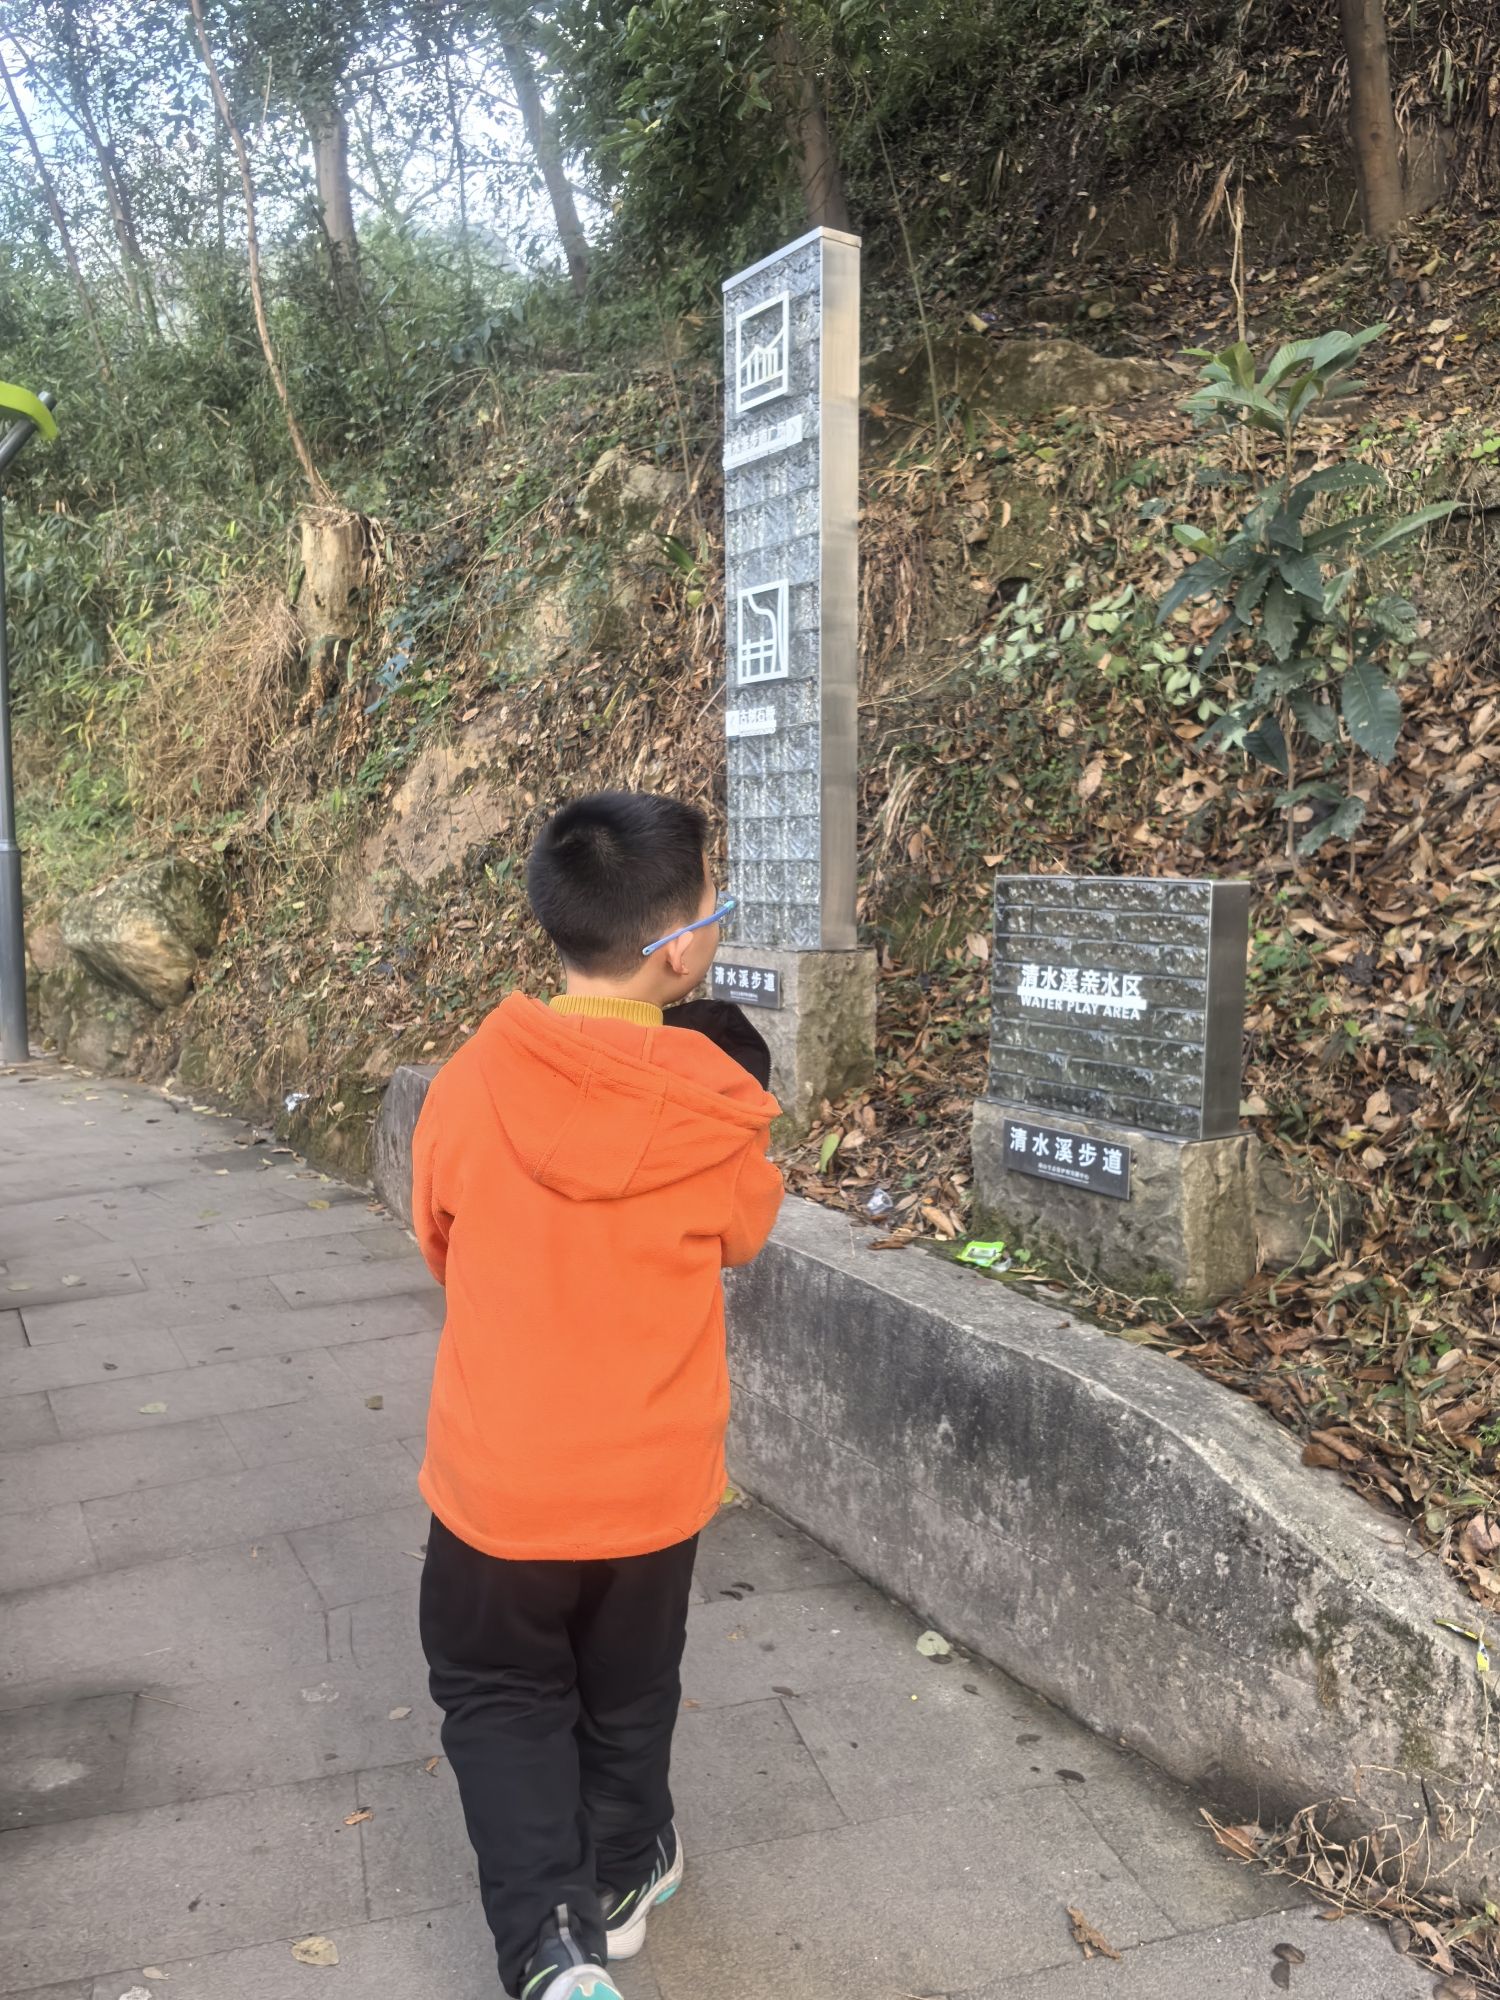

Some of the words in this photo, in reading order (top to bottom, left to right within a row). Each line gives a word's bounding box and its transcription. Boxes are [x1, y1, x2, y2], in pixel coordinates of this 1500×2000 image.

[714, 966, 775, 992] 清水溪步道
[1021, 964, 1142, 998] 清水溪亲水区
[1021, 995, 1062, 1011] WATER
[1066, 999, 1100, 1016] PLAY
[1102, 1005, 1141, 1021] AREA
[1010, 1126, 1122, 1175] 清水溪步道
